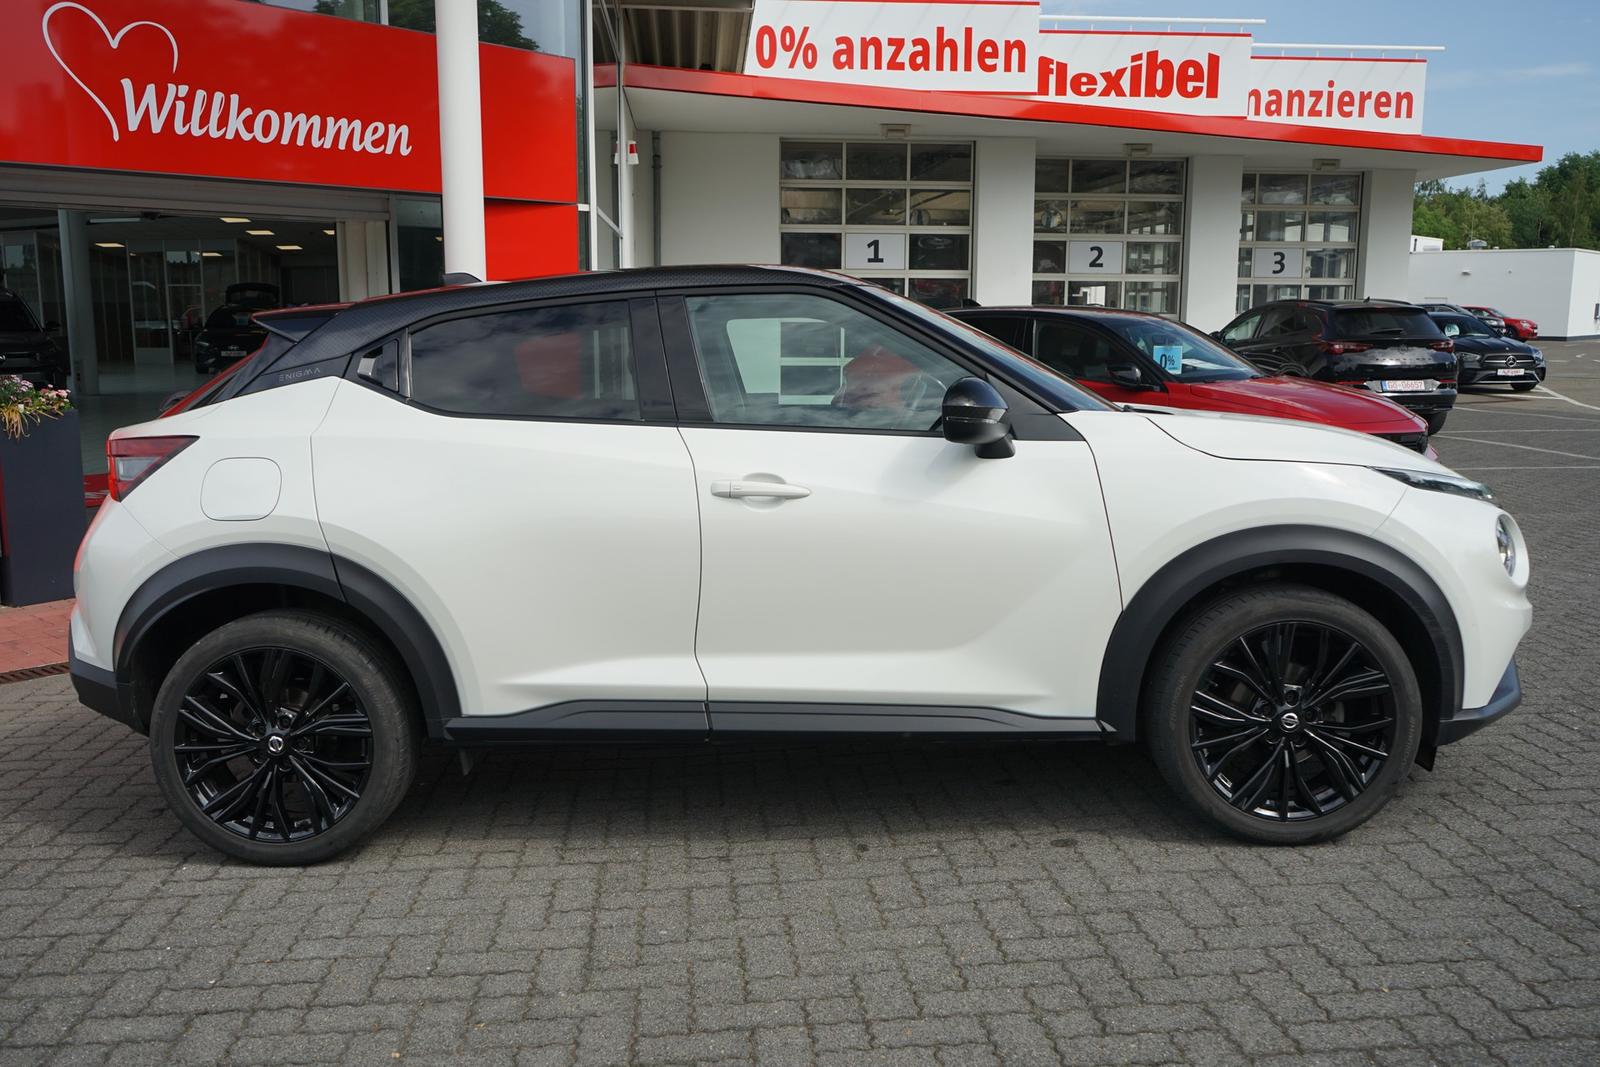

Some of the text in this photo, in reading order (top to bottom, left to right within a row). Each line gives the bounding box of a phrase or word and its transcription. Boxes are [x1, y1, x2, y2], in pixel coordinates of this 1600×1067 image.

[756, 25, 1028, 74] 0% anzahlen
[1038, 50, 1221, 99] flexibel
[120, 78, 412, 157] Willkommen
[867, 240, 883, 262] 1
[1089, 247, 1105, 267] 2
[1271, 252, 1286, 274] 3
[279, 368, 321, 381] ENIGMA
